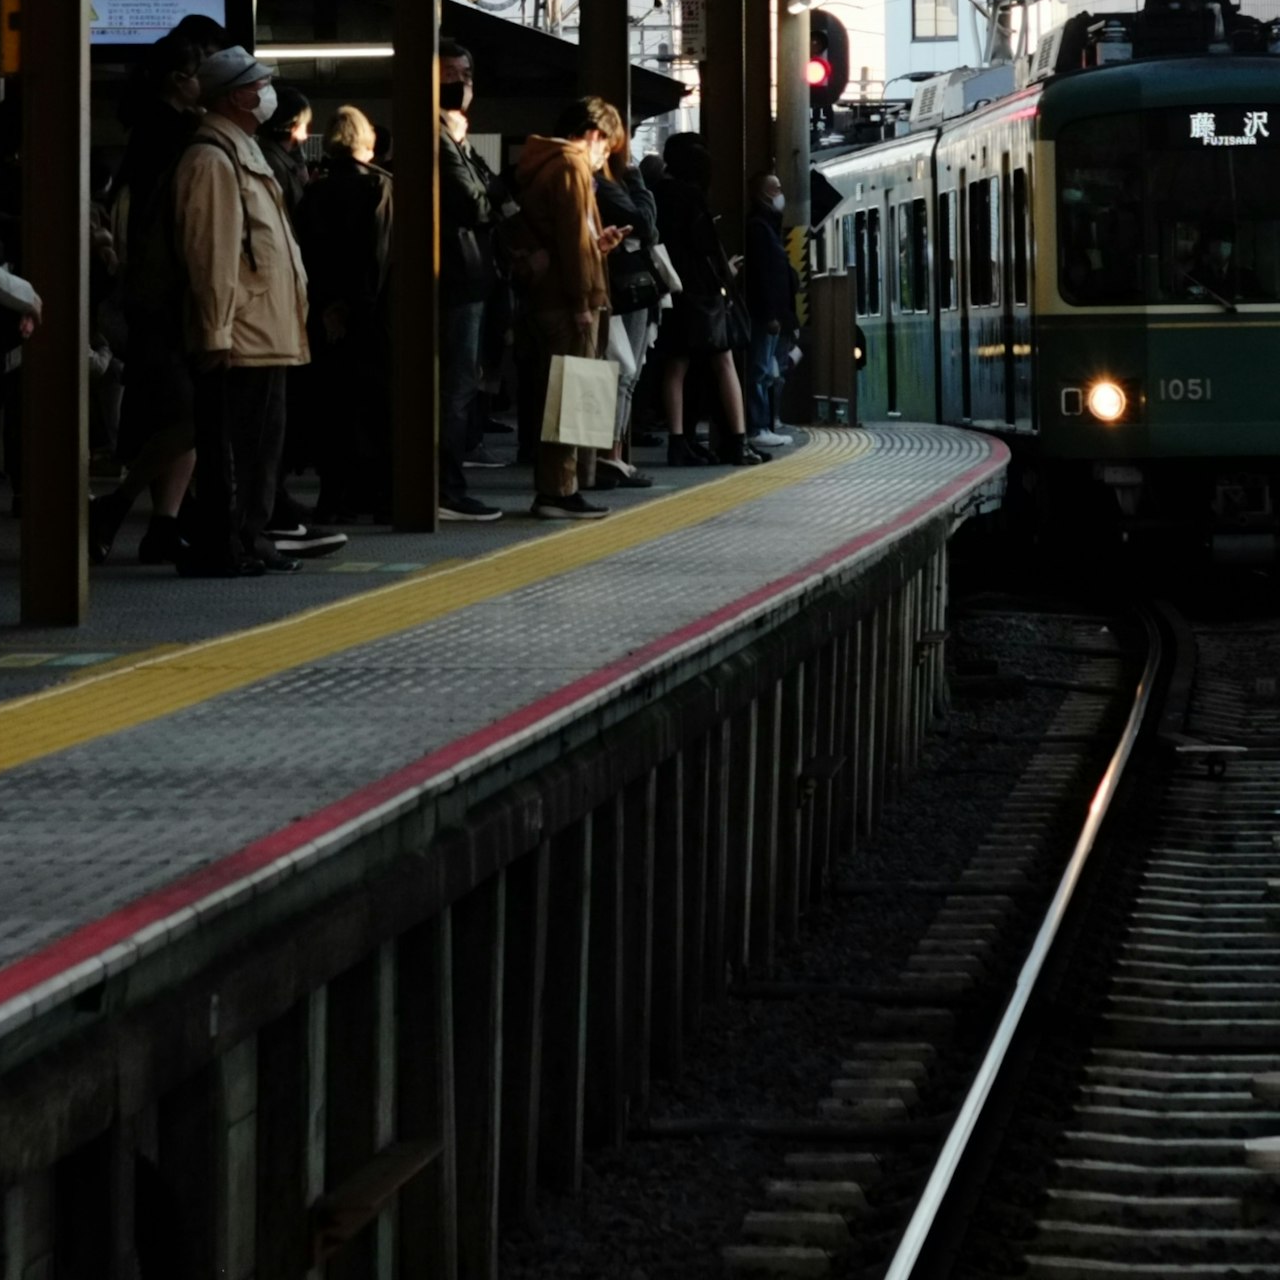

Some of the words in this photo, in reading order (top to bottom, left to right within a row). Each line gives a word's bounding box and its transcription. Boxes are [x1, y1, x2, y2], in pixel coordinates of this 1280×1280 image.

[1189, 111, 1270, 138] 藤沢
[1202, 135, 1257, 146] FUJISAWA
[1159, 378, 1212, 401] 1051
